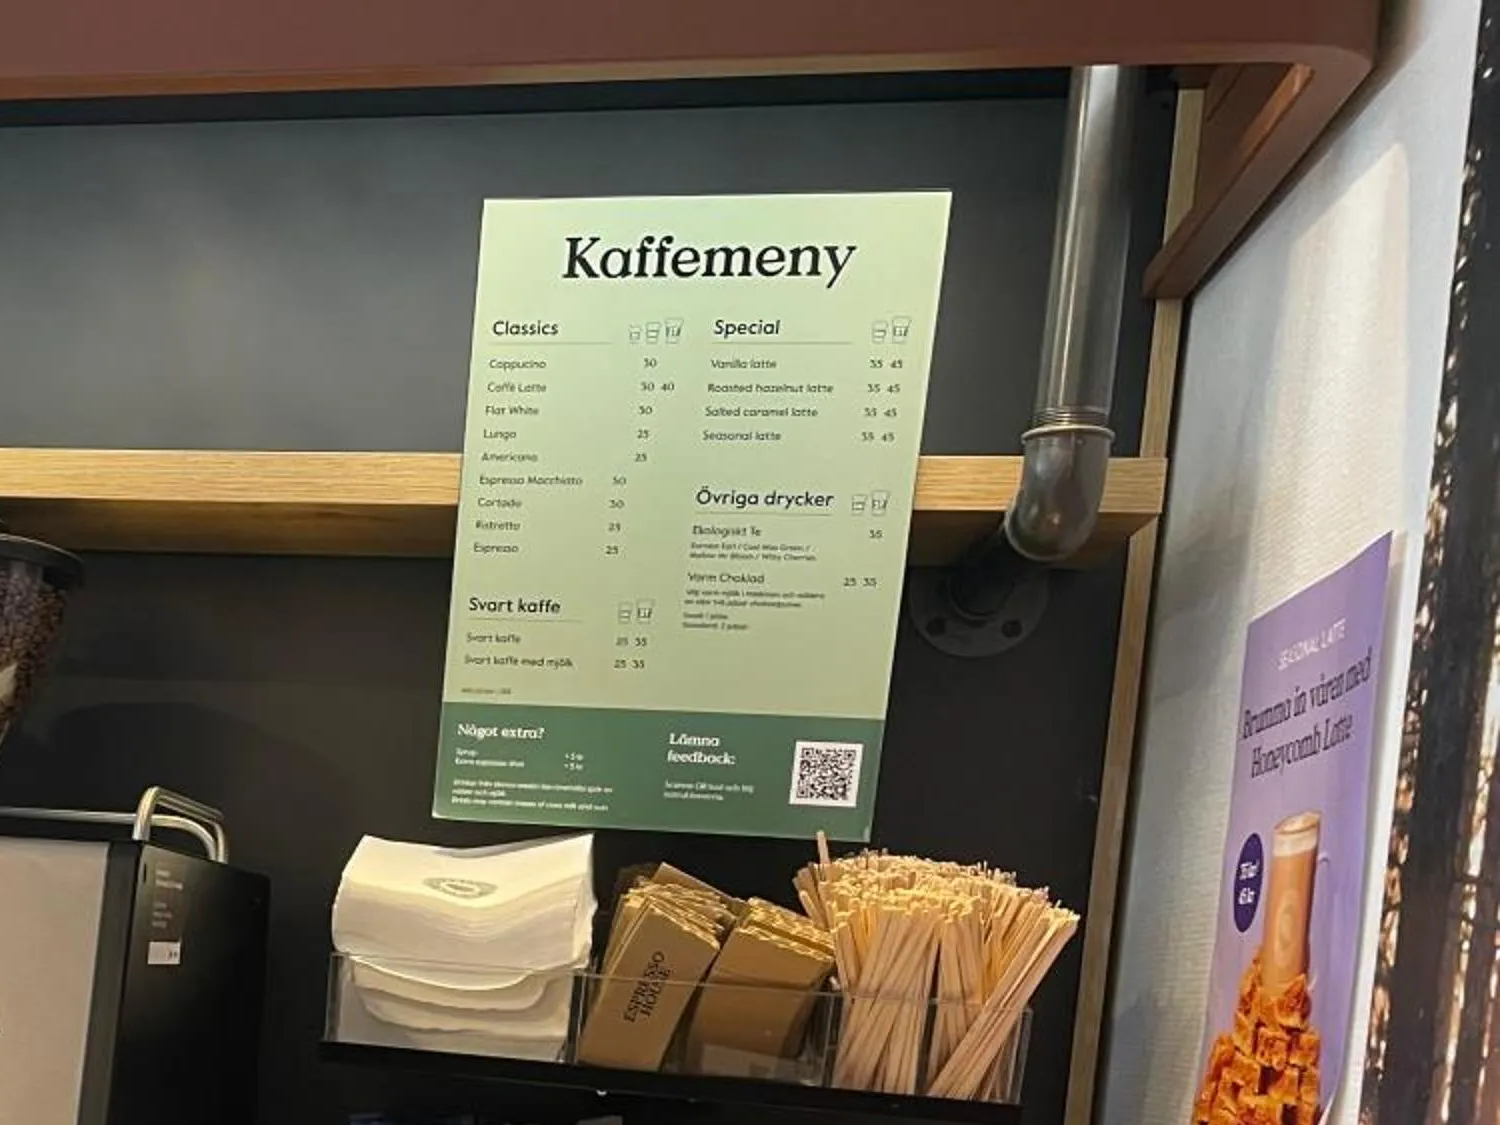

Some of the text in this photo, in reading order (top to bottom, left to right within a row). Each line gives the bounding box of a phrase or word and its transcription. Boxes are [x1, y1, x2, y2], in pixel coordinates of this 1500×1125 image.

[562, 235, 857, 289] Kaffemeny
[493, 319, 559, 336] Classics
[713, 319, 781, 338] Special
[710, 359, 747, 369] Vanilla
[749, 359, 777, 369] latte
[660, 382, 675, 392] 40
[707, 383, 752, 393] Roasted
[806, 384, 834, 393] latte
[485, 405, 506, 416] Flat
[509, 405, 539, 416] White
[705, 407, 741, 417] Salted
[743, 408, 789, 417] caramel
[791, 408, 819, 417] latte
[483, 429, 517, 441] Lungo
[702, 430, 753, 441] Seasonal
[755, 431, 782, 441] latte
[481, 452, 538, 463] Americano
[696, 486, 835, 509] Övriga drycker
[719, 573, 765, 584] Choklad
[469, 597, 561, 614] Svart kaffe
[466, 632, 493, 643] Svart
[495, 633, 521, 643] kaffe
[464, 655, 491, 665] Svart
[493, 656, 519, 666] kaffe
[520, 657, 545, 667] med
[1345, 646, 1373, 692] med
[457, 722, 545, 740] Något extra?
[623, 951, 665, 1022] ESPRESSO
[640, 969, 672, 1017] HOUSE
